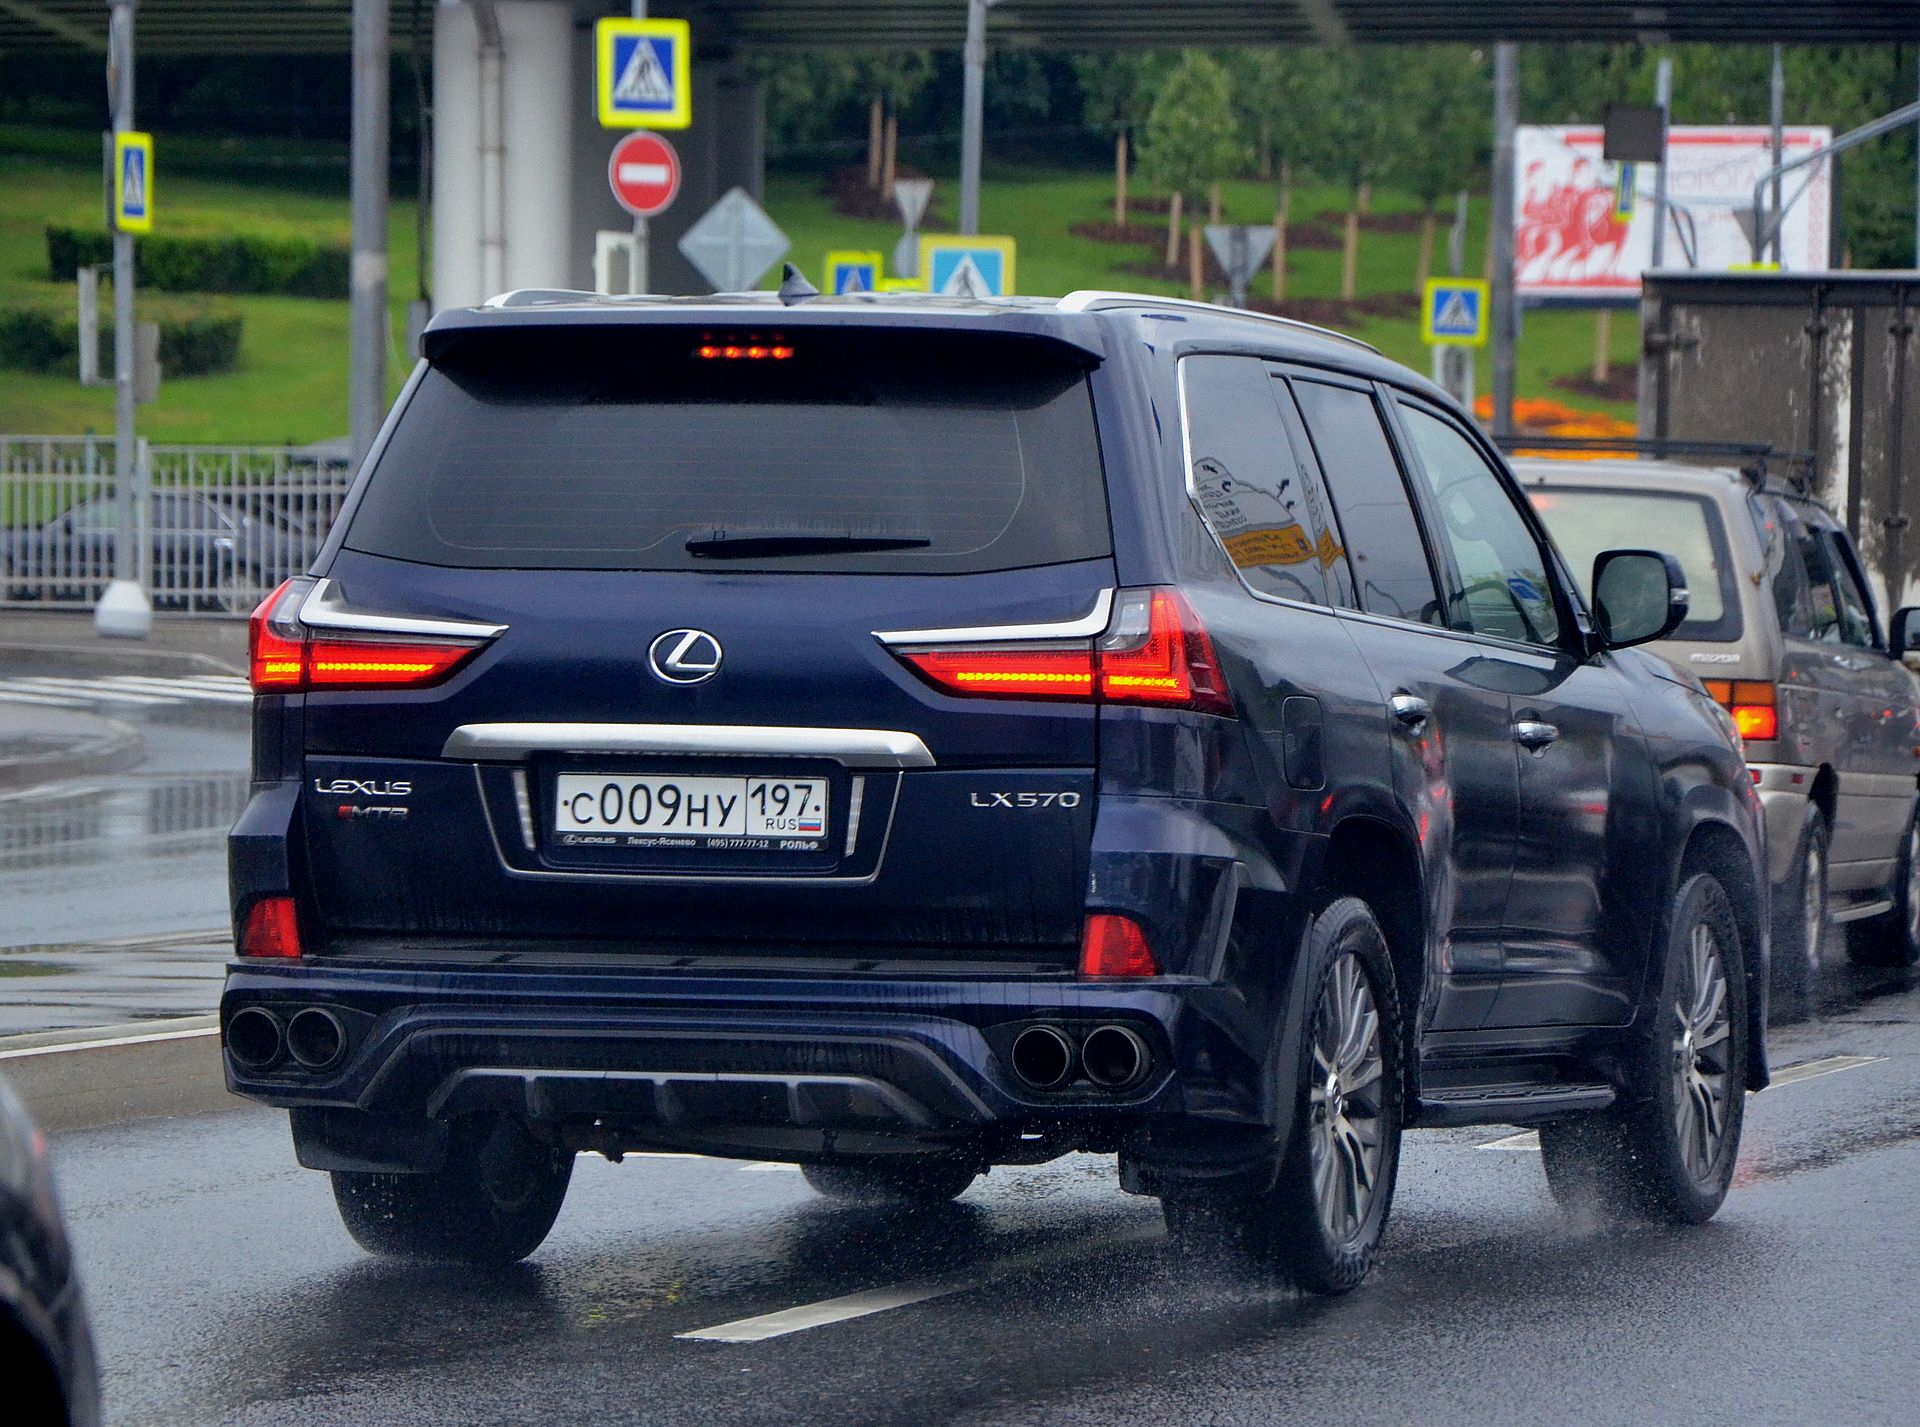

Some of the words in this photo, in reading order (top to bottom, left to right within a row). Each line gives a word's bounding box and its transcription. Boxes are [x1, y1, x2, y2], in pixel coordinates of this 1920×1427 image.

[314, 778, 412, 796] LEXUS
[750, 783, 813, 816] 197
[765, 817, 797, 831] RUS
[627, 836, 697, 847] Лексус-Ясенево
[707, 838, 728, 849] (495)
[729, 839, 770, 849] 777-77-12
[779, 840, 819, 850] РОЛЬФ
